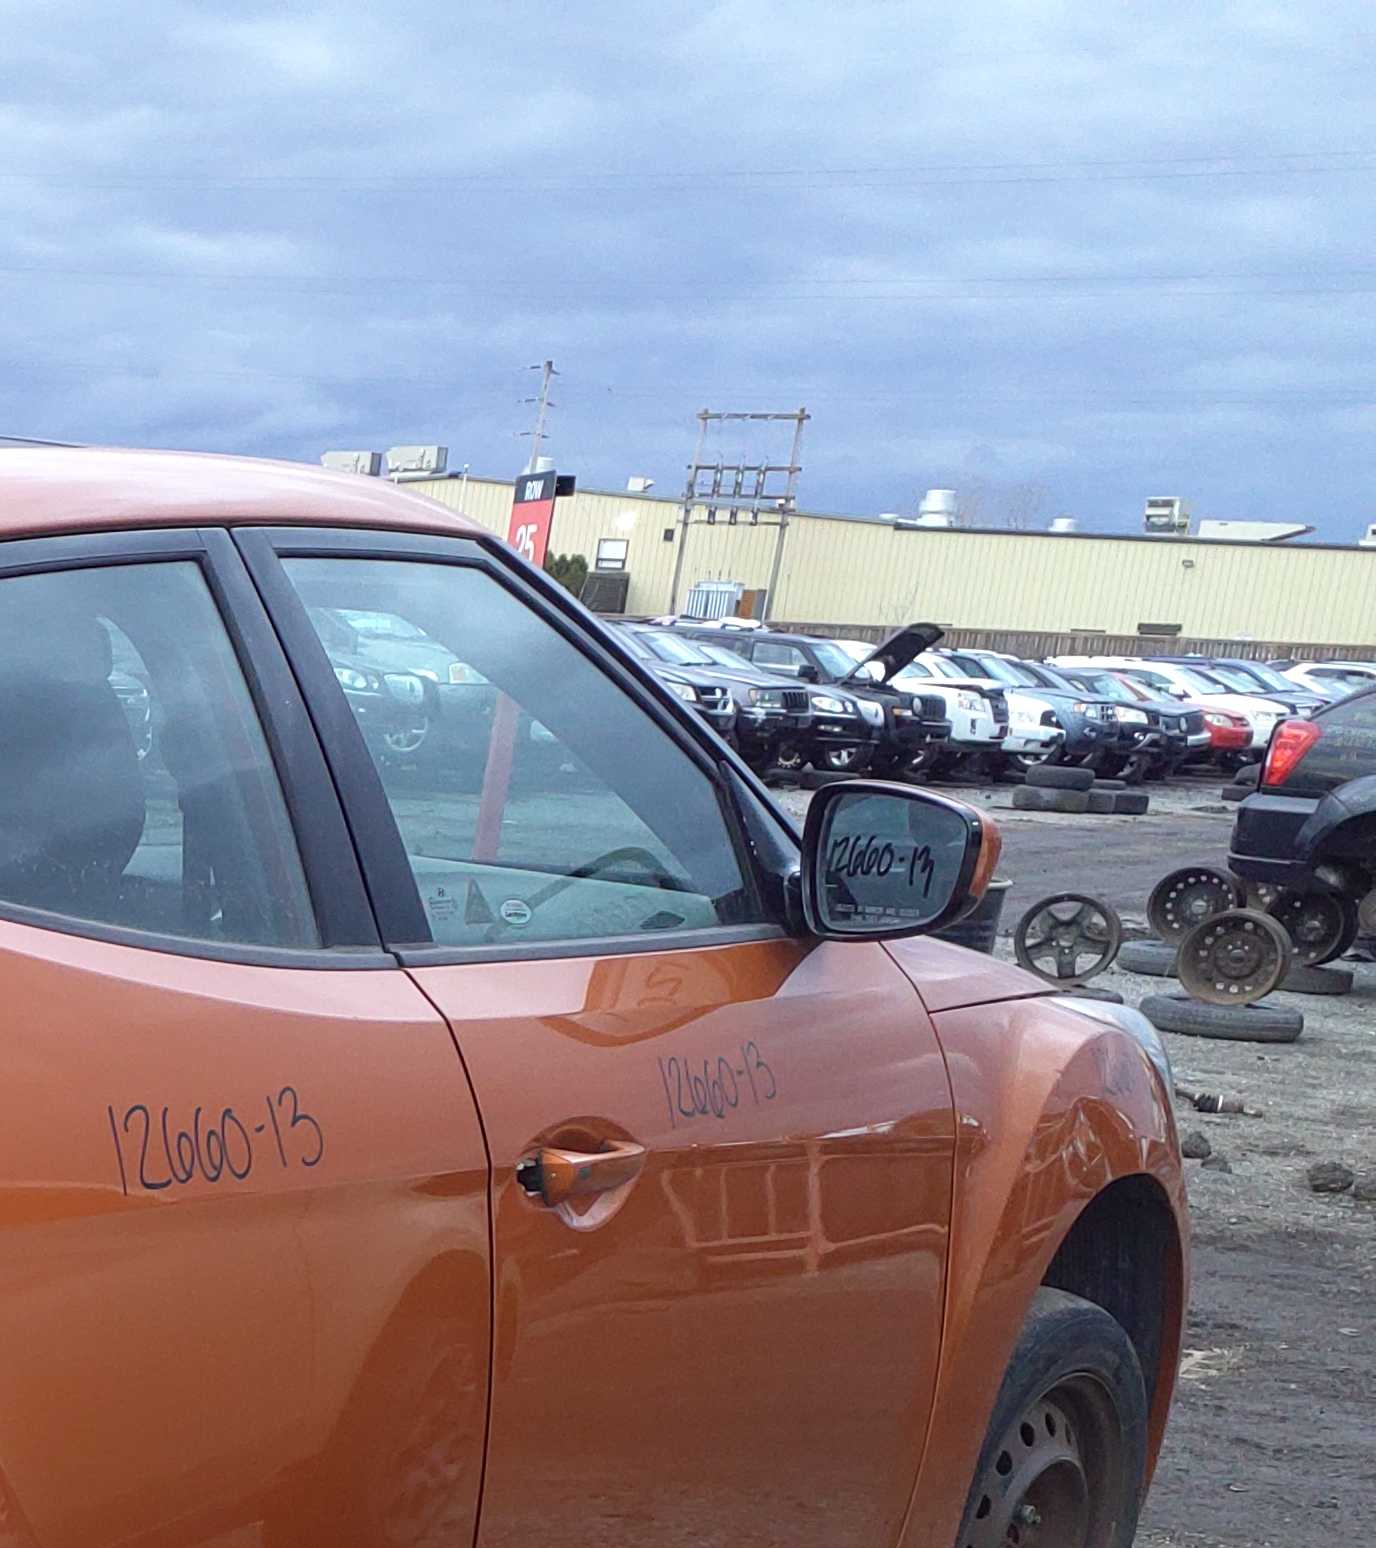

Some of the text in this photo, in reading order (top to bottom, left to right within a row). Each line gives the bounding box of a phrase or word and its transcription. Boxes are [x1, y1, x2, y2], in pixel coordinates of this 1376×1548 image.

[524, 479, 544, 500] ROW
[830, 835, 936, 898] 12660-13
[656, 1040, 778, 1123] 12660-13
[107, 1085, 324, 1197] 12660-13
